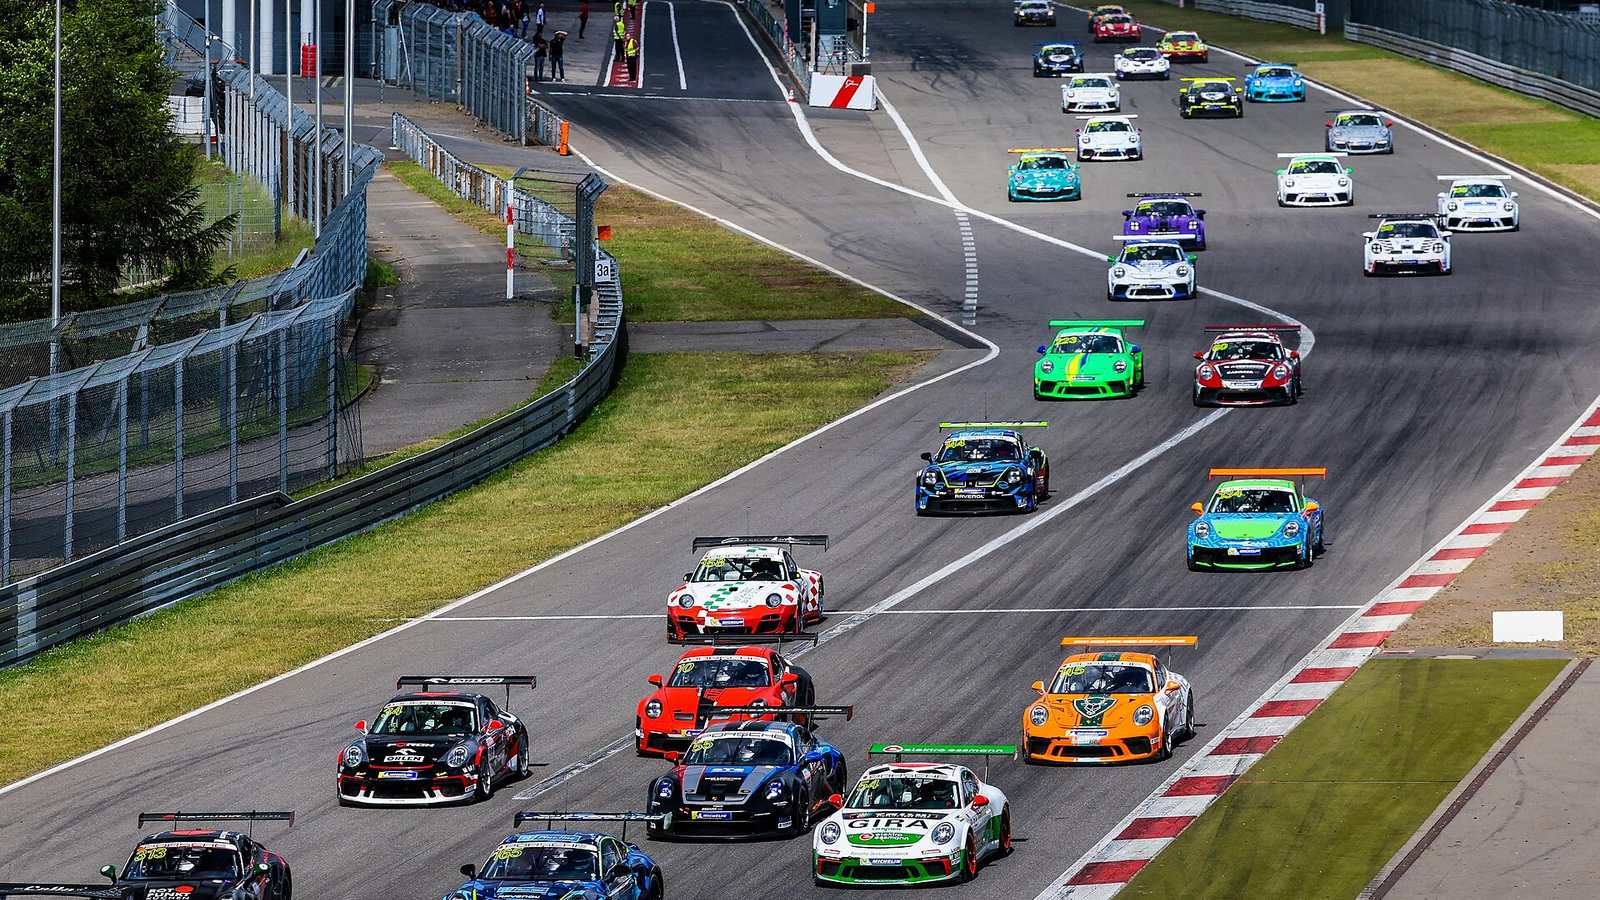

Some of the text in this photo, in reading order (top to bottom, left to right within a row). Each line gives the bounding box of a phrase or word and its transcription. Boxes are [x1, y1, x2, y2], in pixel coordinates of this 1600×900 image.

[597, 263, 609, 277] 3a
[848, 819, 928, 830] GIRA
[133, 848, 167, 862] 313
